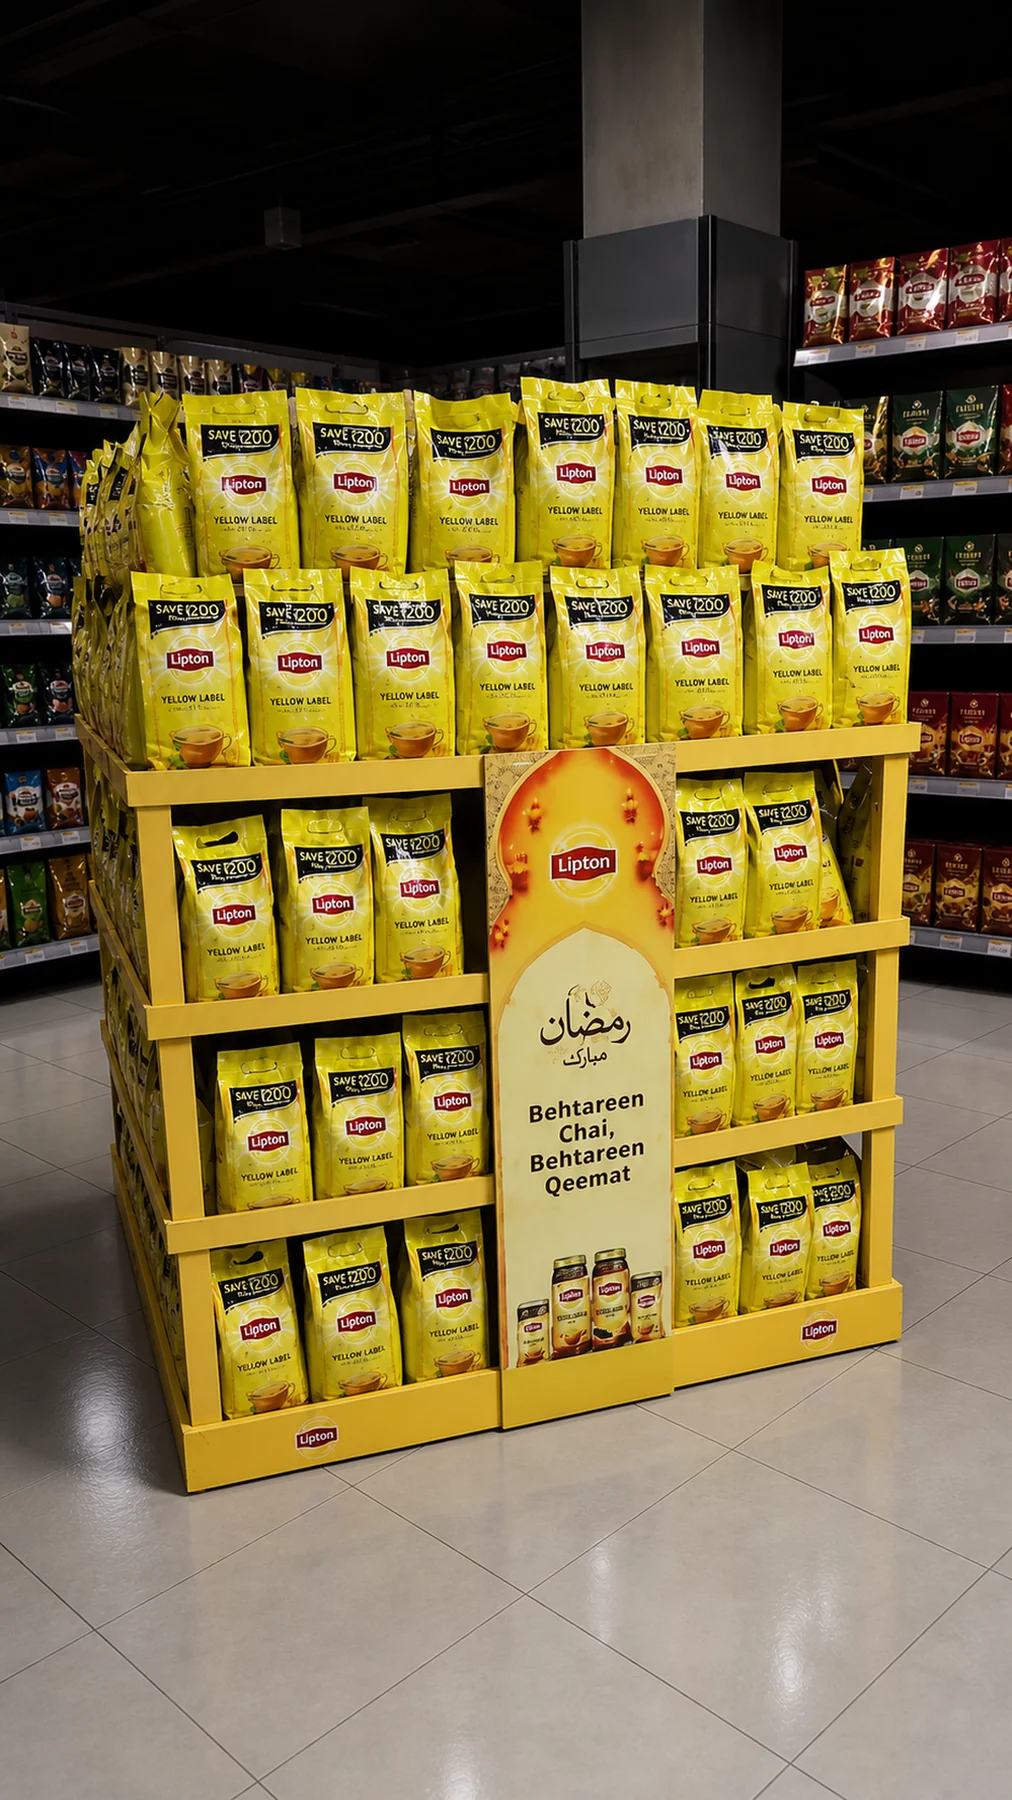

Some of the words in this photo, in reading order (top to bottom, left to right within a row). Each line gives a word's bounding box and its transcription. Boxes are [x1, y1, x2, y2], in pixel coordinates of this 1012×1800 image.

[544, 417, 570, 430] SAVE
[633, 419, 657, 433] SAVE
[208, 428, 237, 442] SAVE
[320, 427, 350, 439] SAVE
[436, 434, 462, 447] SAVE
[799, 434, 823, 447] SAVE
[560, 467, 592, 481] Lipton
[649, 469, 679, 483] Lipton
[225, 478, 262, 492] Lipton
[337, 475, 373, 490] Lipton
[452, 480, 486, 493] Lipton
[729, 475, 758, 488] Lipton
[815, 479, 844, 493] Lipton
[548, 506, 580, 516] YELLOW
[213, 516, 249, 525] YELLOW
[324, 514, 360, 525] YELLOW
[439, 516, 472, 526] YELLOW
[156, 604, 184, 616] SAVE
[475, 599, 498, 610] SAVE
[571, 601, 596, 612] SAVE
[667, 598, 692, 609] SAVE
[265, 607, 292, 619] SAVE
[372, 604, 399, 617] SAVE
[782, 634, 813, 646] Lipton
[861, 629, 891, 641] Lipton
[490, 644, 523, 658] Lipton
[589, 646, 621, 658] Lipton
[684, 641, 716, 654] Lipton
[171, 652, 210, 667] Lipton
[281, 656, 319, 670] Lipton
[390, 651, 426, 666] Lipton
[479, 683, 512, 691] YELLOW
[579, 684, 610, 692] YELLOW
[675, 679, 706, 687] YELLOW
[161, 695, 197, 704] YELLOW
[270, 697, 303, 706] YELLOW
[379, 692, 413, 701] YELLOW
[300, 851, 324, 862] SAVE
[776, 848, 804, 859] Lipton
[197, 863, 222, 874] SAVE
[558, 855, 611, 876] Lipton
[699, 859, 730, 872] Lipton
[403, 883, 436, 894] Lipton
[316, 898, 350, 911] Lipton
[217, 908, 252, 923] Lipton
[395, 920, 425, 929] YELLOW
[305, 936, 336, 944] YELLOW
[207, 946, 240, 956] YELLOW
[540, 991, 631, 1046] رمضان
[757, 1040, 783, 1052] Lipton
[817, 1036, 842, 1047] Lipton
[420, 1053, 444, 1064] SAVE
[562, 1047, 608, 1069] مبارك
[692, 1055, 719, 1067] Lipton
[333, 1075, 356, 1087] SAVE
[235, 1090, 259, 1102] SAVE
[437, 1096, 468, 1109] Lipton
[528, 1092, 644, 1124] Behtareen
[349, 1120, 382, 1133] Lipton
[559, 1119, 615, 1144] Chai,
[251, 1135, 285, 1149] Lipton
[427, 1131, 457, 1141] YELLOW
[338, 1156, 371, 1165] YELLOW
[529, 1141, 645, 1173] Behtareen
[241, 1172, 273, 1182] YELLOW
[544, 1165, 631, 1197] Qeemat
[824, 1224, 849, 1235] Lipton
[695, 1244, 723, 1257] Lipton
[772, 1242, 798, 1254] Lipton
[323, 1274, 347, 1285] SAVE
[224, 1280, 248, 1293] SAVE
[438, 1291, 468, 1305] Lipton
[340, 1314, 372, 1329] Lipton
[244, 1320, 277, 1338] Lipton
[805, 1323, 834, 1337] Lipton
[237, 1358, 268, 1372] YELLOW
[299, 1429, 334, 1445] Lipton
